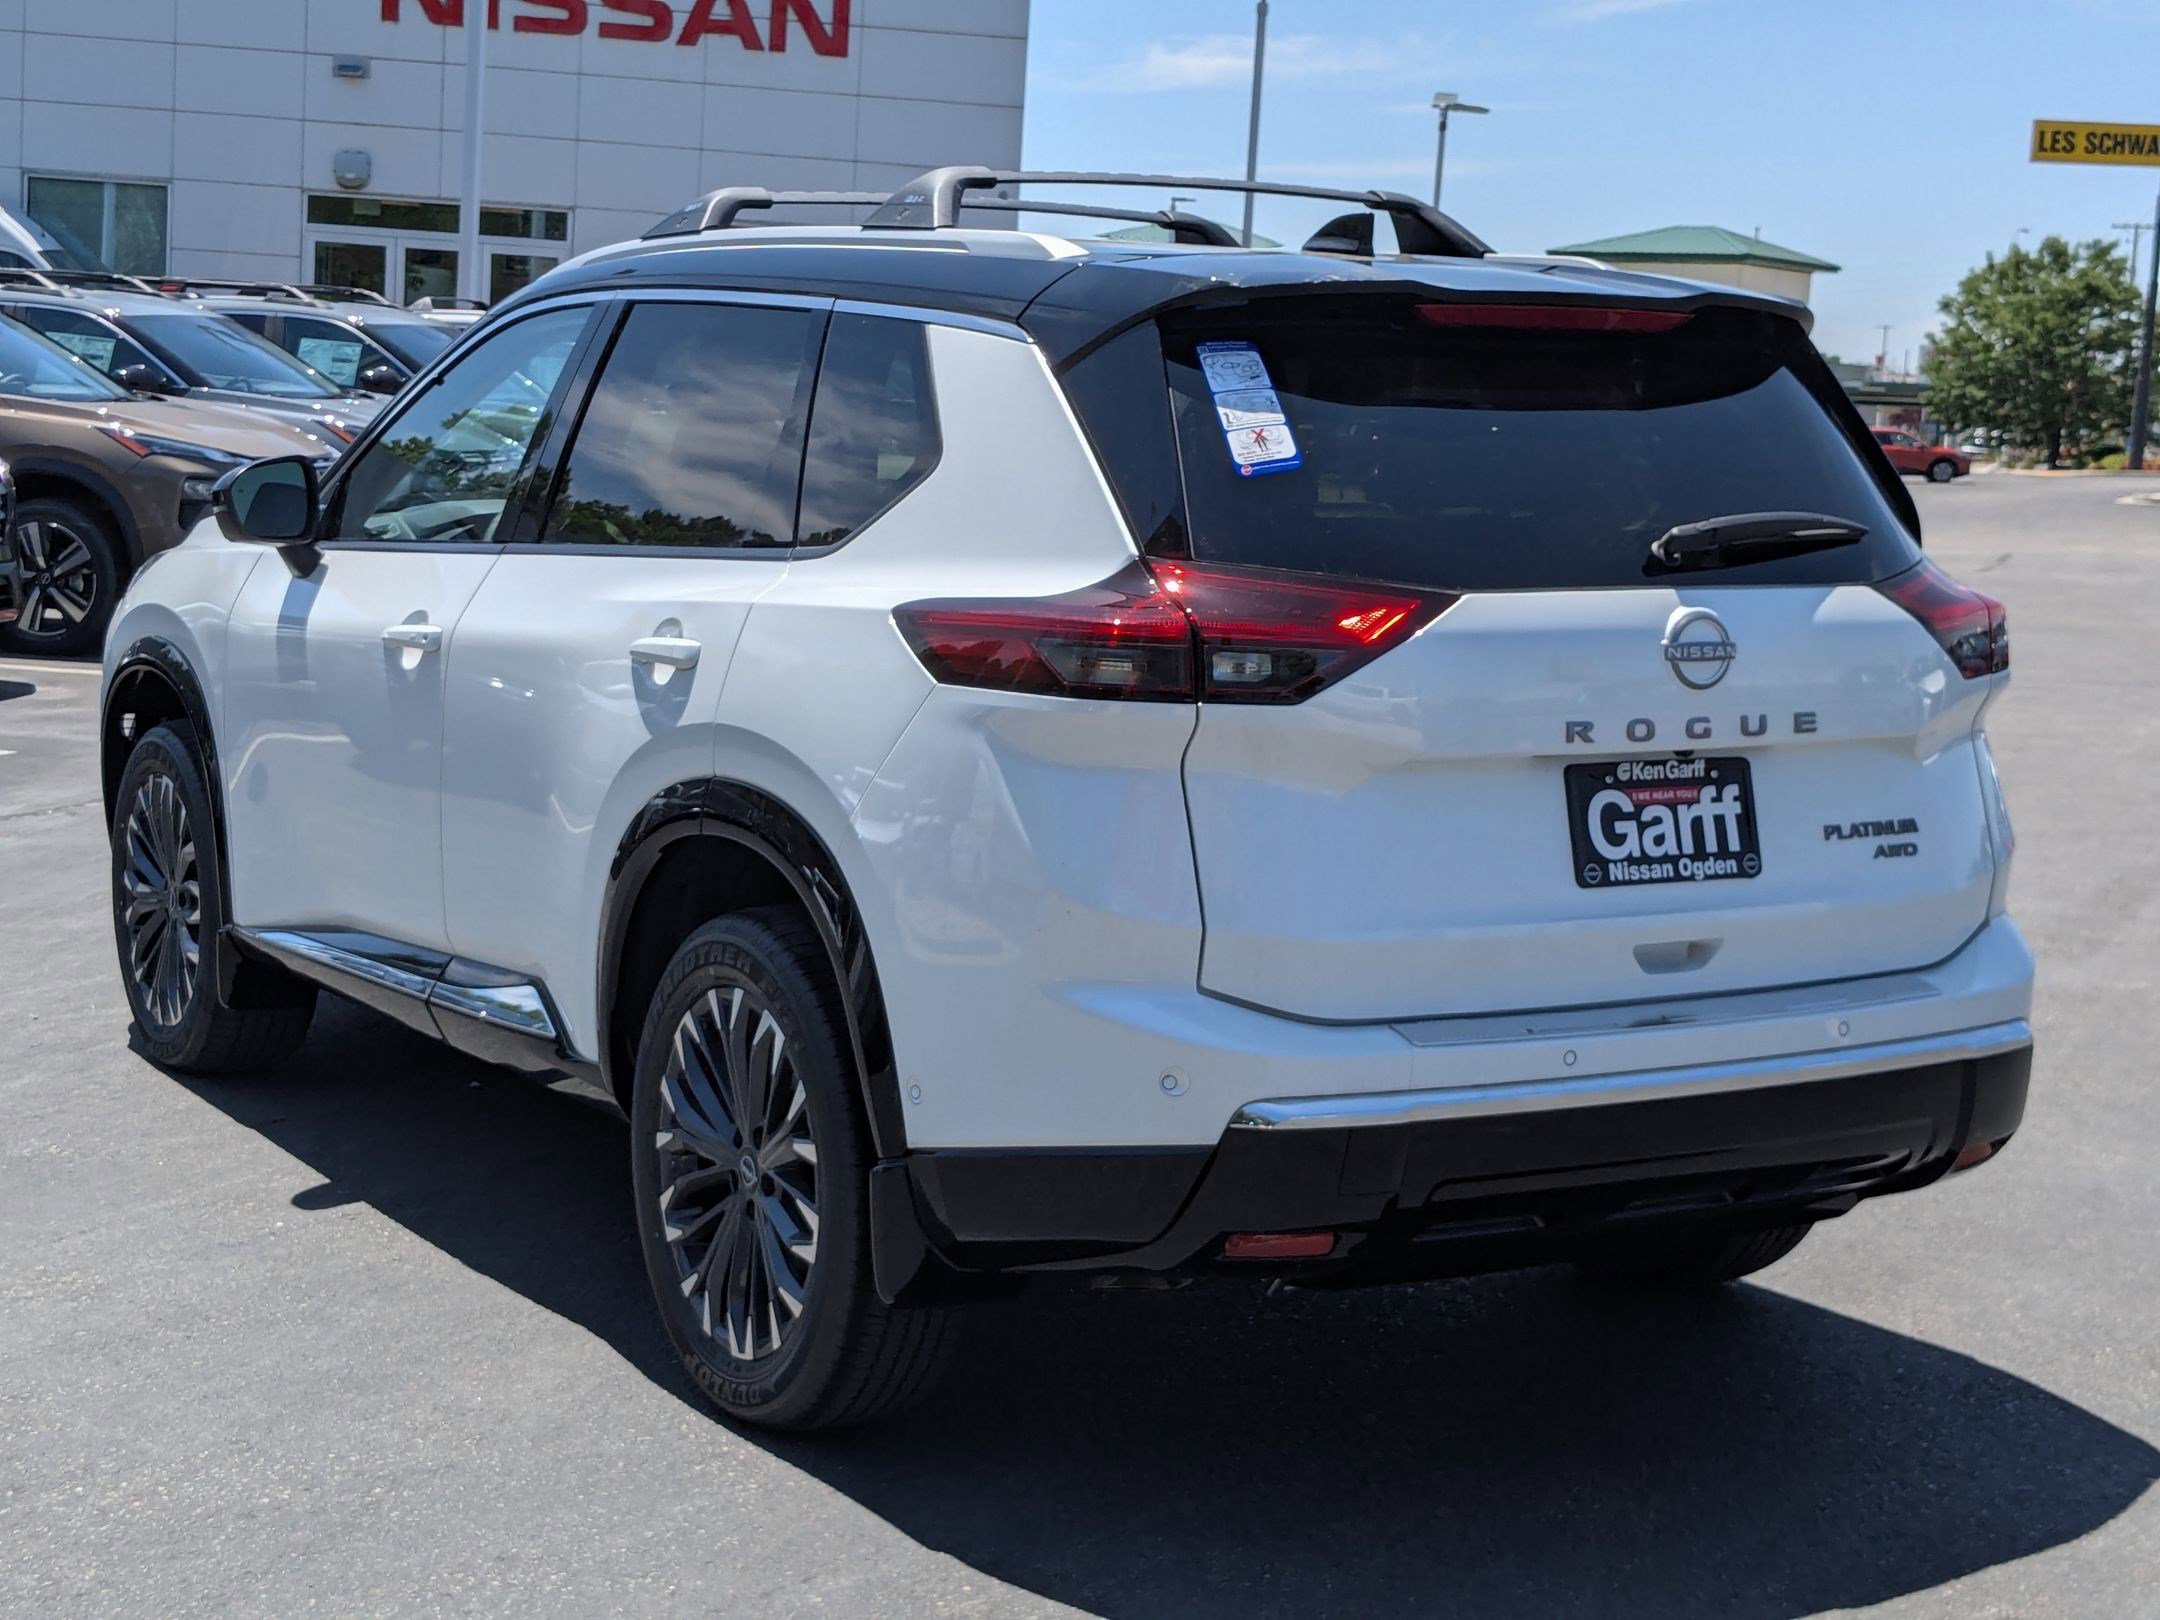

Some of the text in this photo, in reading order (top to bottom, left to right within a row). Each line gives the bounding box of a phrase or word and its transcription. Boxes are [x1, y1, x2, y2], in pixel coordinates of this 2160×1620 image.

[2038, 130, 2075, 154] LES
[1668, 645, 1736, 659] NISSAN
[1565, 711, 1818, 744] ROGUE
[1652, 789, 1675, 800] HEAR
[1588, 784, 1742, 860] Garff
[1823, 818, 1919, 841] PLATINUM
[1873, 842, 1918, 860] AWD
[1608, 856, 1738, 882] Nissan Ogden
